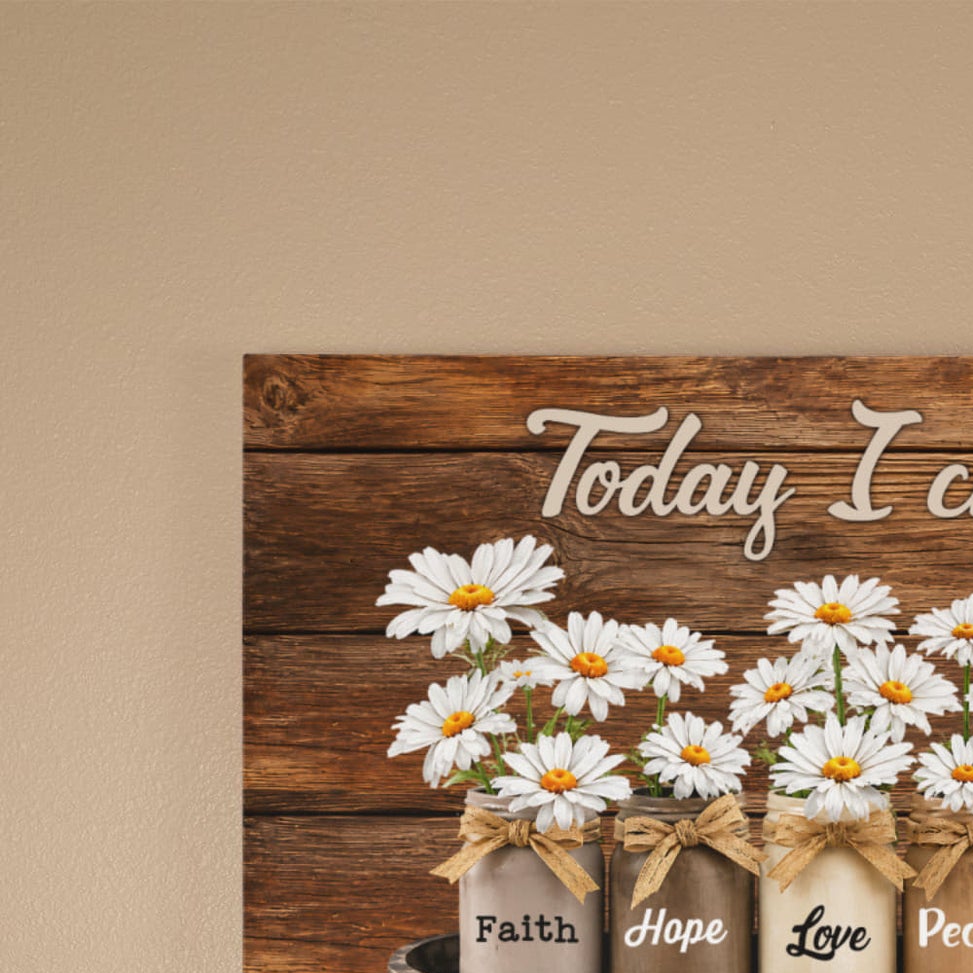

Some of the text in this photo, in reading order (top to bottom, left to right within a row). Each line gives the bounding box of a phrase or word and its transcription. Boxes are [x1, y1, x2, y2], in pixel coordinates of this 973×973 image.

[526, 405, 796, 562] Today
[827, 399, 924, 521] I
[475, 914, 579, 943] Faith
[623, 908, 728, 953] Hope
[786, 904, 871, 961] Love
